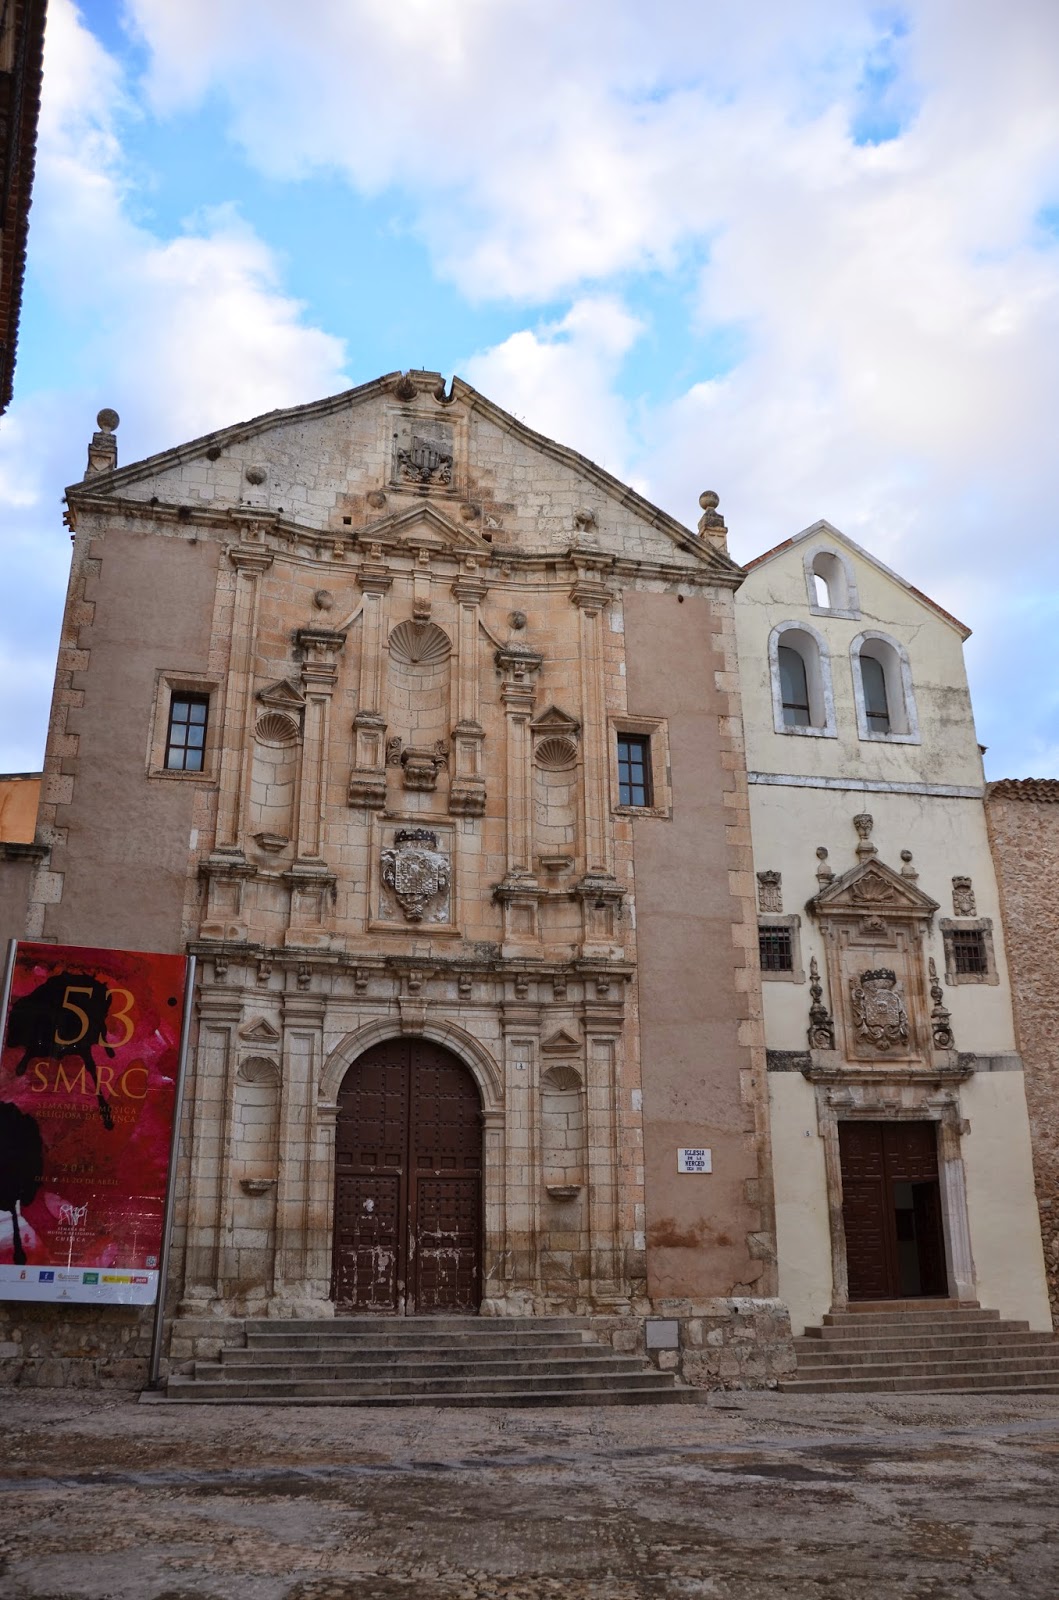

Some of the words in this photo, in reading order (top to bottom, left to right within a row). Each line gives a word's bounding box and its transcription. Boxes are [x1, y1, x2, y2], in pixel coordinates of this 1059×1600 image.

[54, 985, 135, 1049] 53
[31, 1061, 149, 1099] SMRC
[36, 1102, 77, 1111] SEMANA
[81, 1104, 93, 1112] DE
[35, 1110, 81, 1119] RELIGIOSA
[85, 1112, 97, 1121] DE
[99, 1113, 136, 1123] CUENCA
[60, 1163, 94, 1173] 2014
